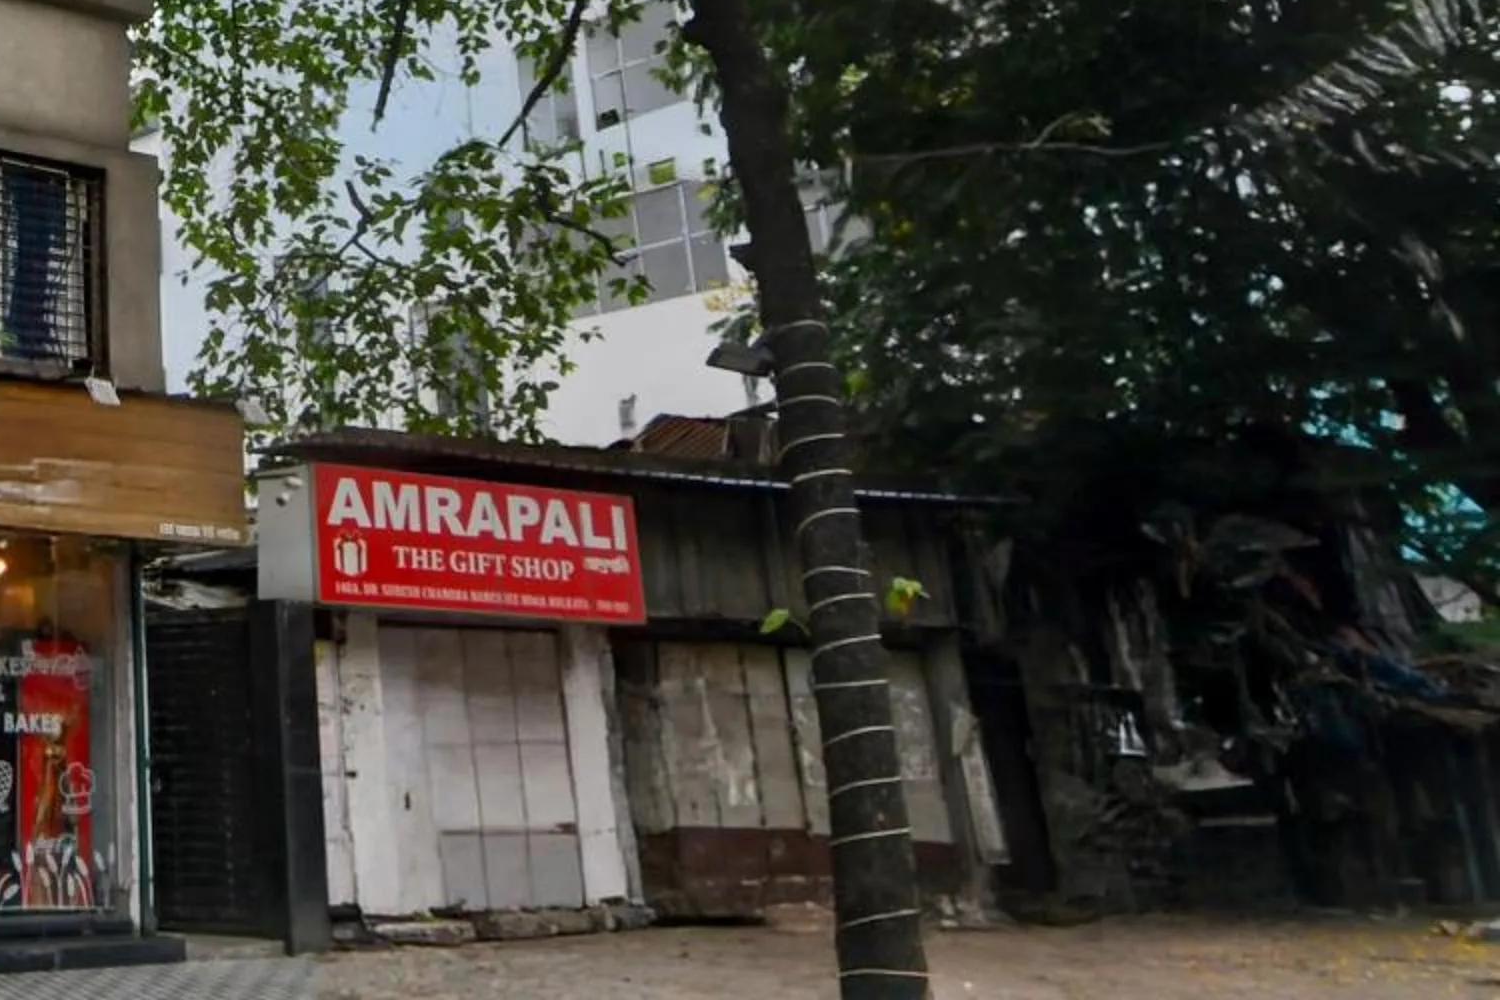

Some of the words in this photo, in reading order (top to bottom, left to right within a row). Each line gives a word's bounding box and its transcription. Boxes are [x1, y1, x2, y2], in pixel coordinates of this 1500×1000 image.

[327, 477, 627, 551] AMRAPALI
[392, 545, 445, 572] THE
[449, 551, 507, 576] GIFT
[511, 556, 575, 582] SHOP
[3, 712, 62, 734] BAKES
